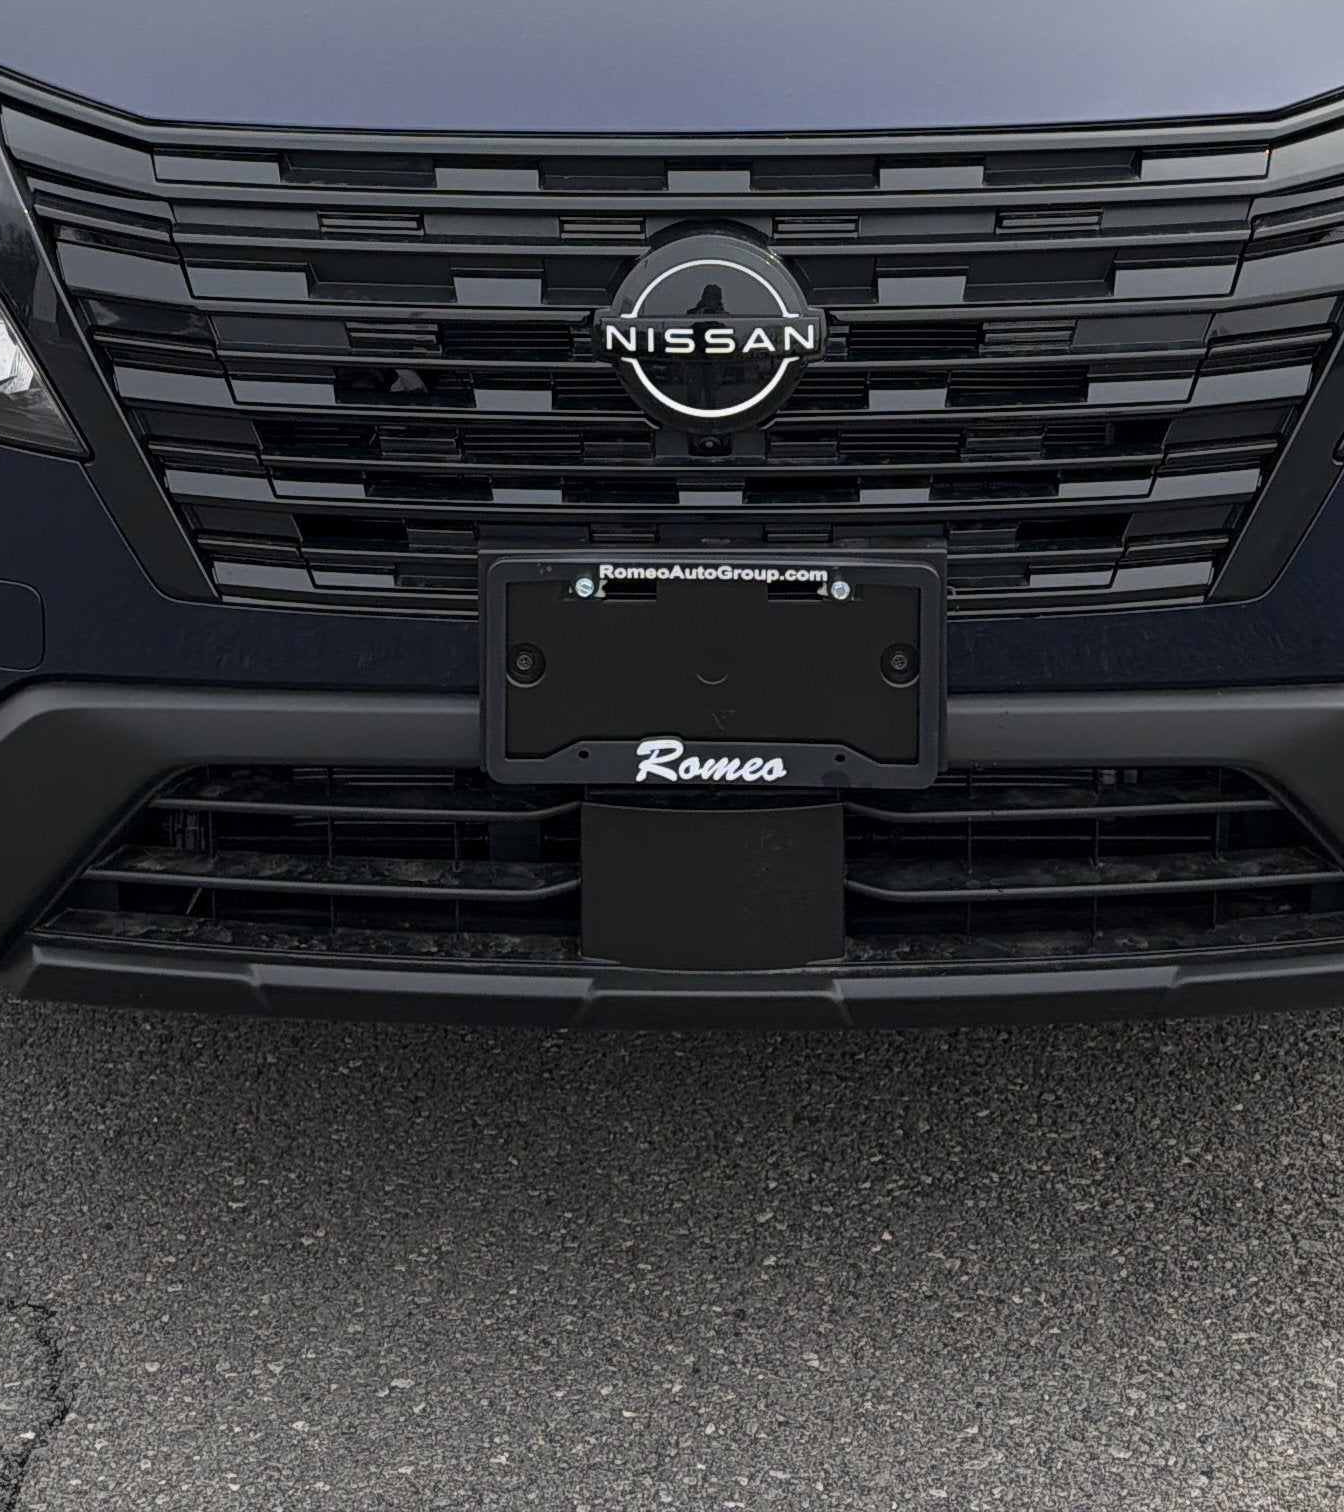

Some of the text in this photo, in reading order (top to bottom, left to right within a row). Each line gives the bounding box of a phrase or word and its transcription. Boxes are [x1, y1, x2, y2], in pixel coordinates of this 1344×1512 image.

[605, 324, 815, 354] NISSAN
[599, 564, 828, 584] RomeoAutoGroup.com
[635, 738, 787, 782] Romeo
